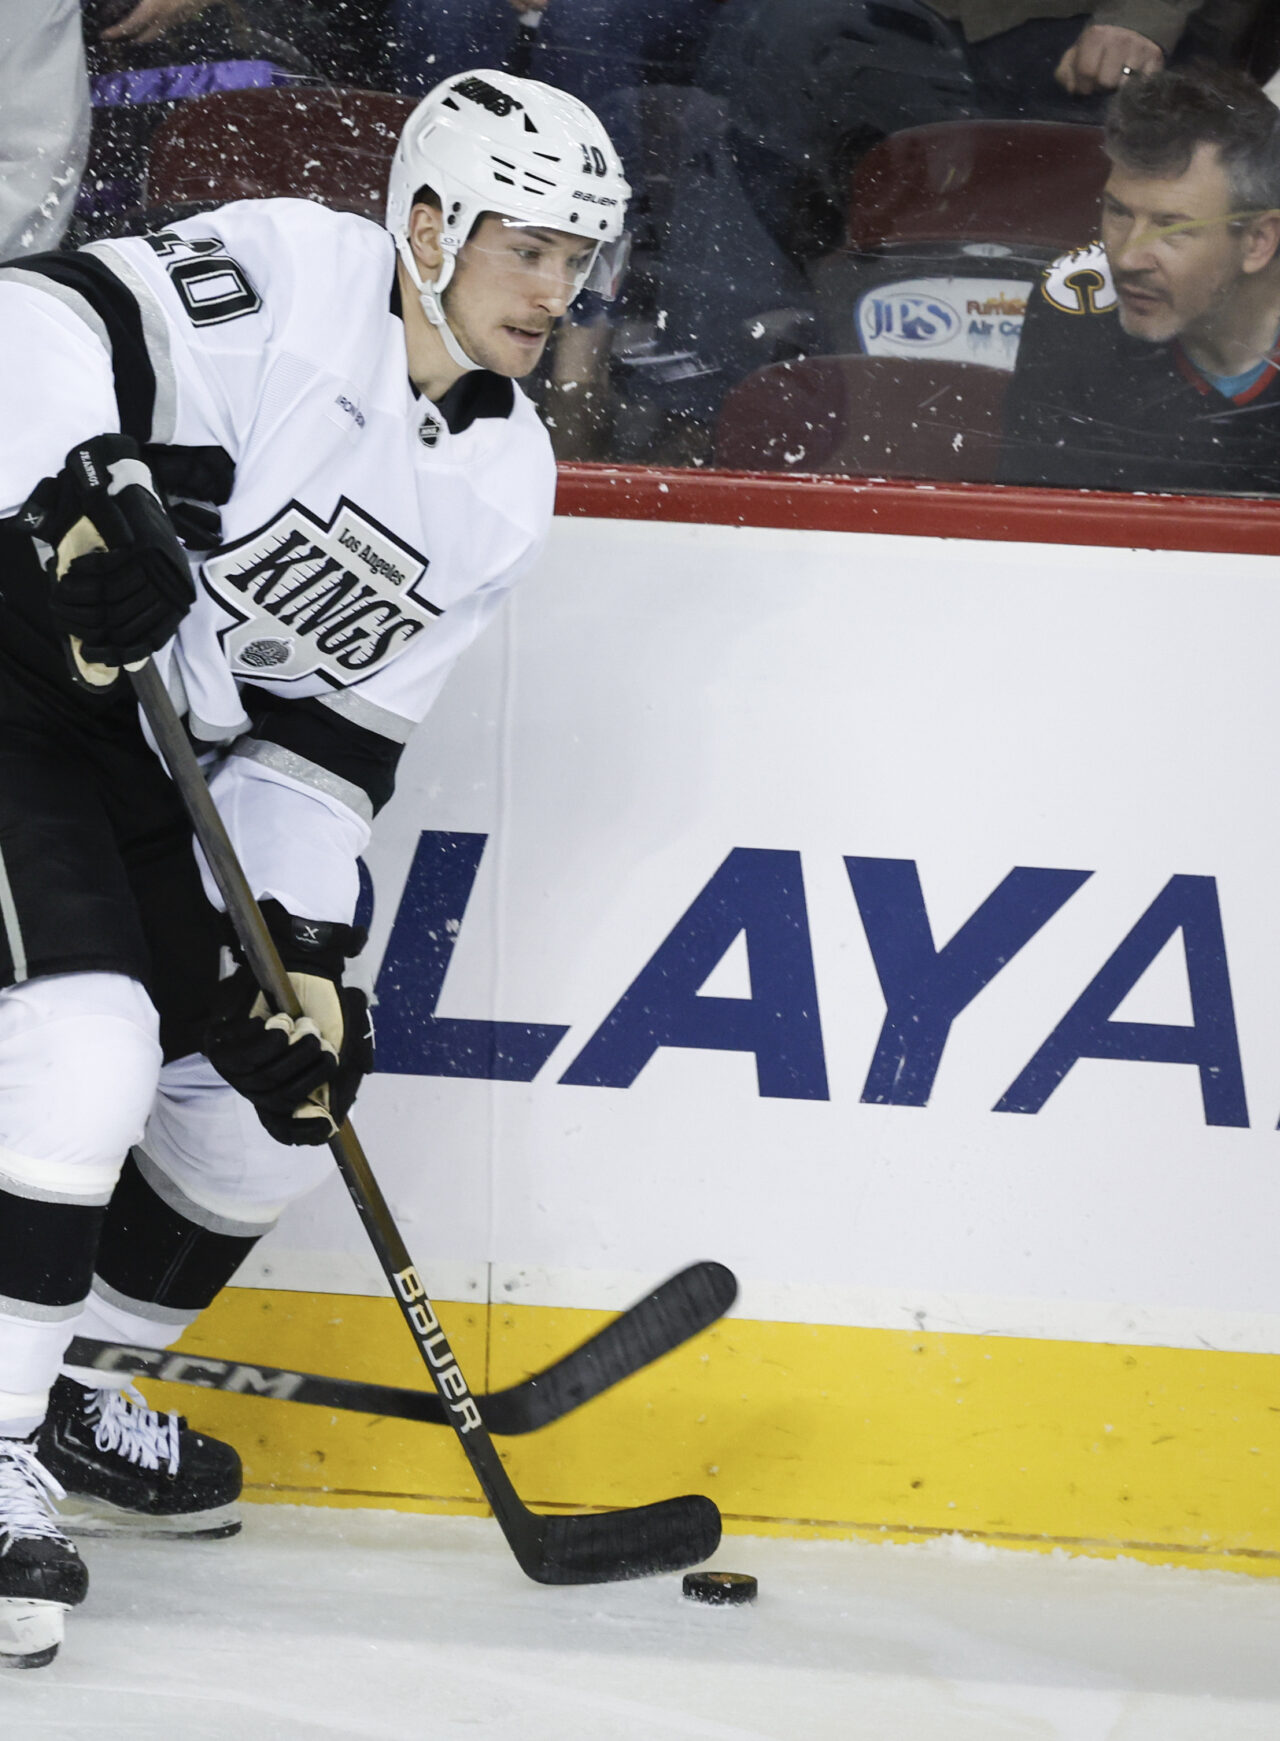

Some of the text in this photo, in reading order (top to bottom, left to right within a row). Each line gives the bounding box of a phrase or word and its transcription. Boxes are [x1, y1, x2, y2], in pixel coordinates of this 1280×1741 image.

[868, 299, 952, 340] JPS
[338, 528, 406, 586] Los Angeles
[224, 529, 425, 671] KINGS
[353, 831, 1280, 1128] LAYA
[93, 1347, 305, 1399] CCM
